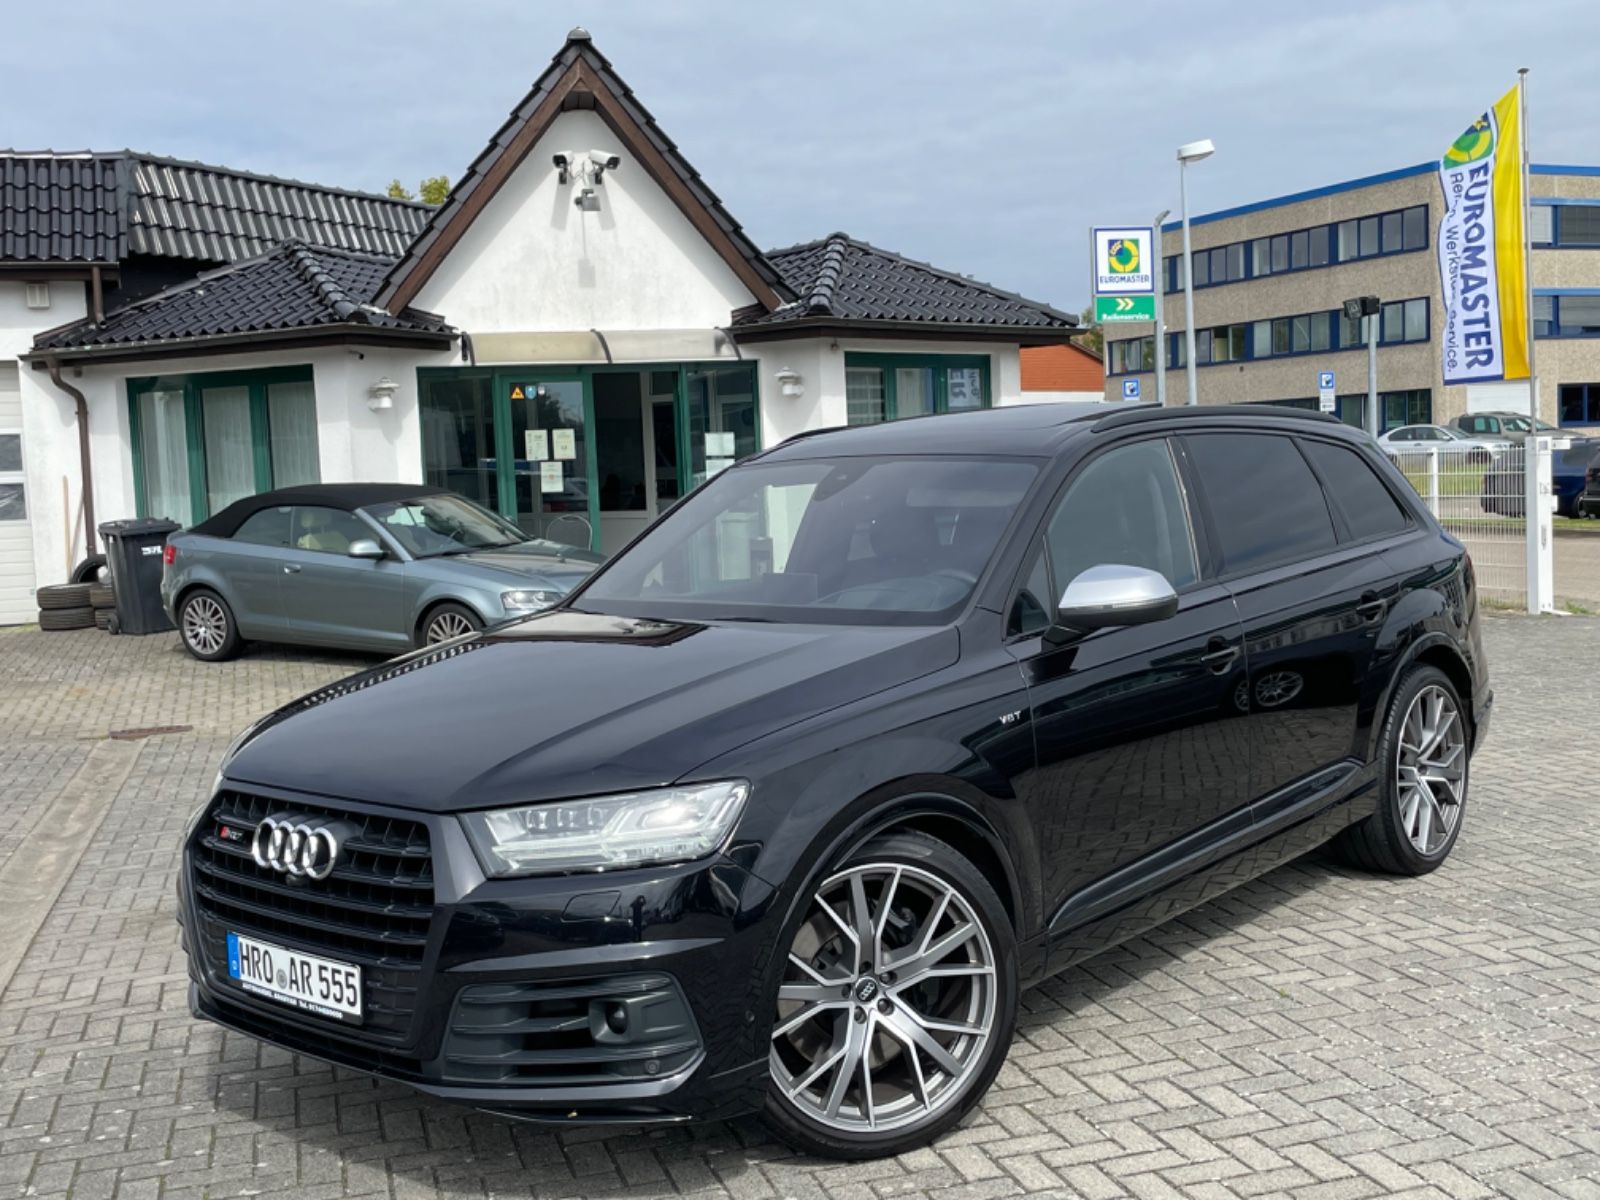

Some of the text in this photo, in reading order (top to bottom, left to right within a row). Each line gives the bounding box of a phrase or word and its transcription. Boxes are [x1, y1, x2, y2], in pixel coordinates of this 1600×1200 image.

[1099, 274, 1150, 284] EUROMASTER
[1461, 161, 1494, 370] EUROMASTER
[240, 942, 358, 1007] HRO AR 555
